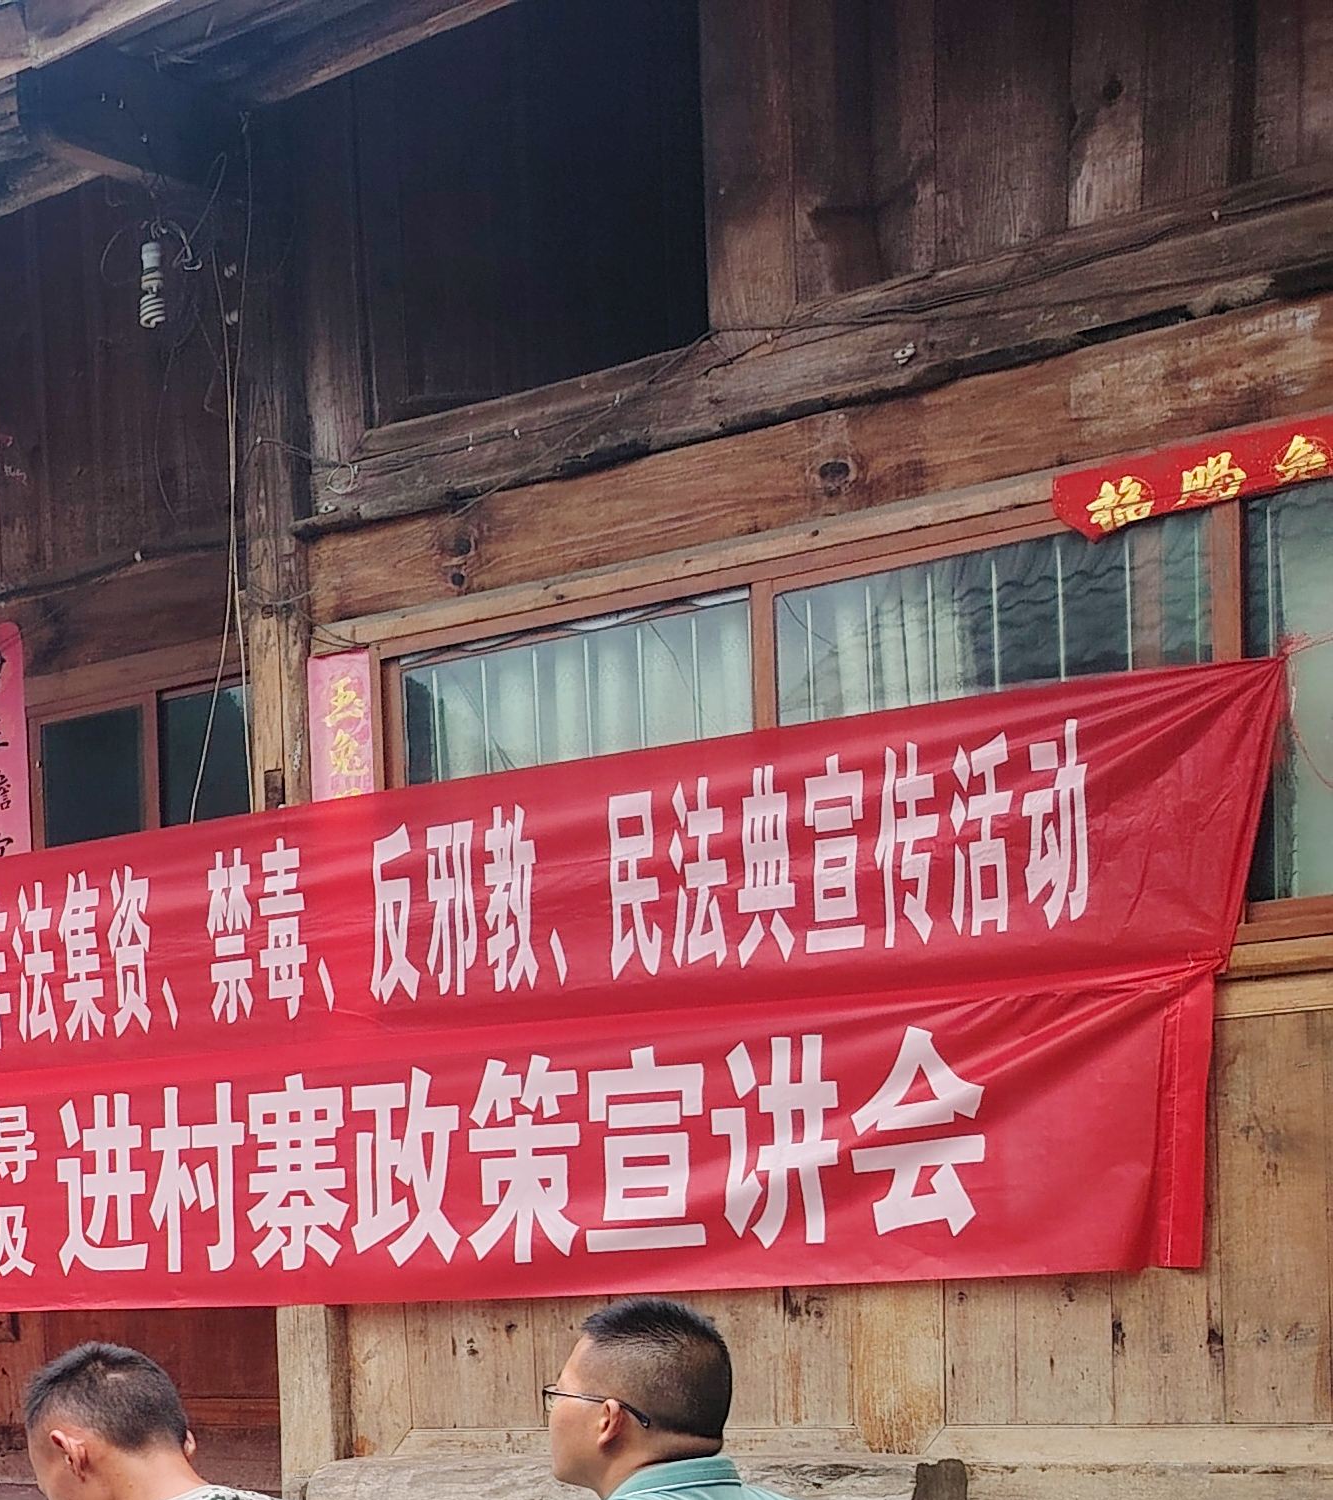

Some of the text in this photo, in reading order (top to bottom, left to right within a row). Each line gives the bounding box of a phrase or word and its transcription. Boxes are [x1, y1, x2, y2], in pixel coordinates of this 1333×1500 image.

[55, 1024, 988, 1277] 进村寨政策宣讲会
